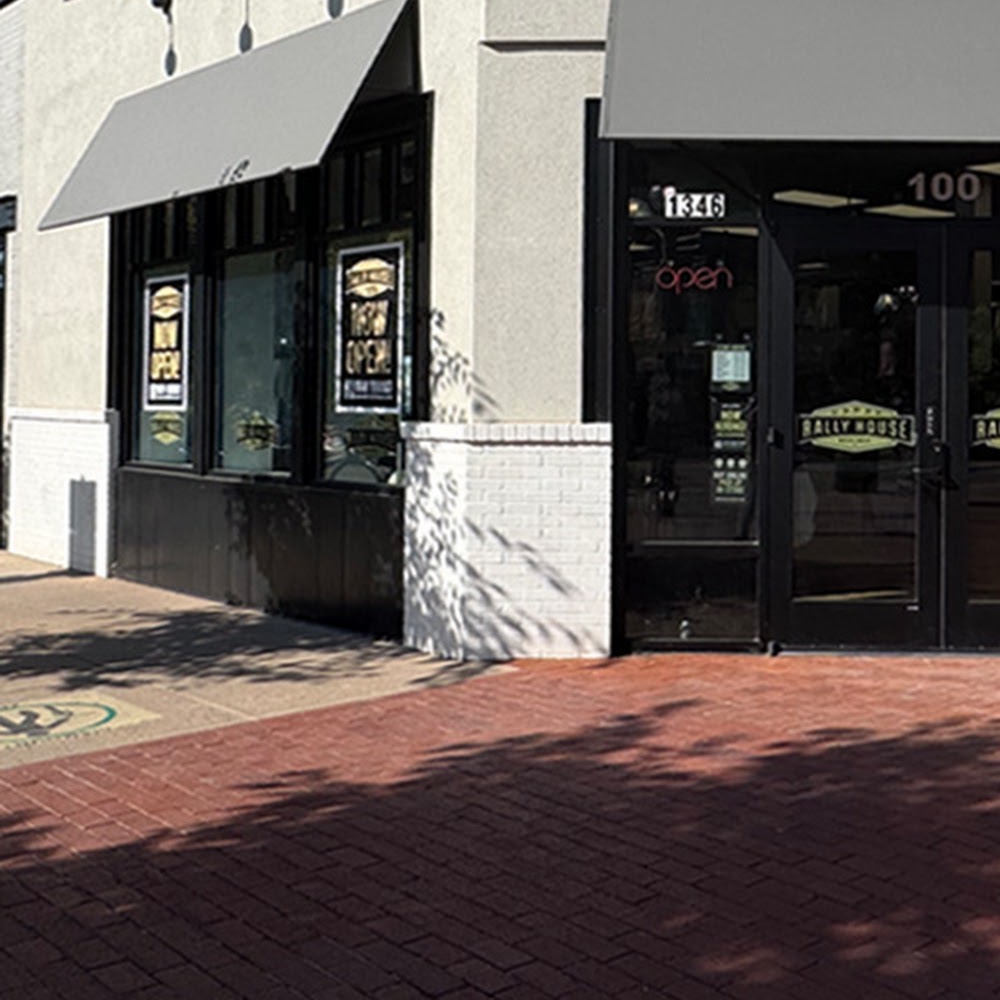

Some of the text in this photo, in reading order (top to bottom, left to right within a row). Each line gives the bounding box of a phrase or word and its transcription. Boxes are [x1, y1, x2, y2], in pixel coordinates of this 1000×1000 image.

[907, 172, 981, 201] 100
[668, 193, 724, 218] 1346
[655, 266, 733, 295] open
[802, 419, 908, 440] RALLY HOUSE
